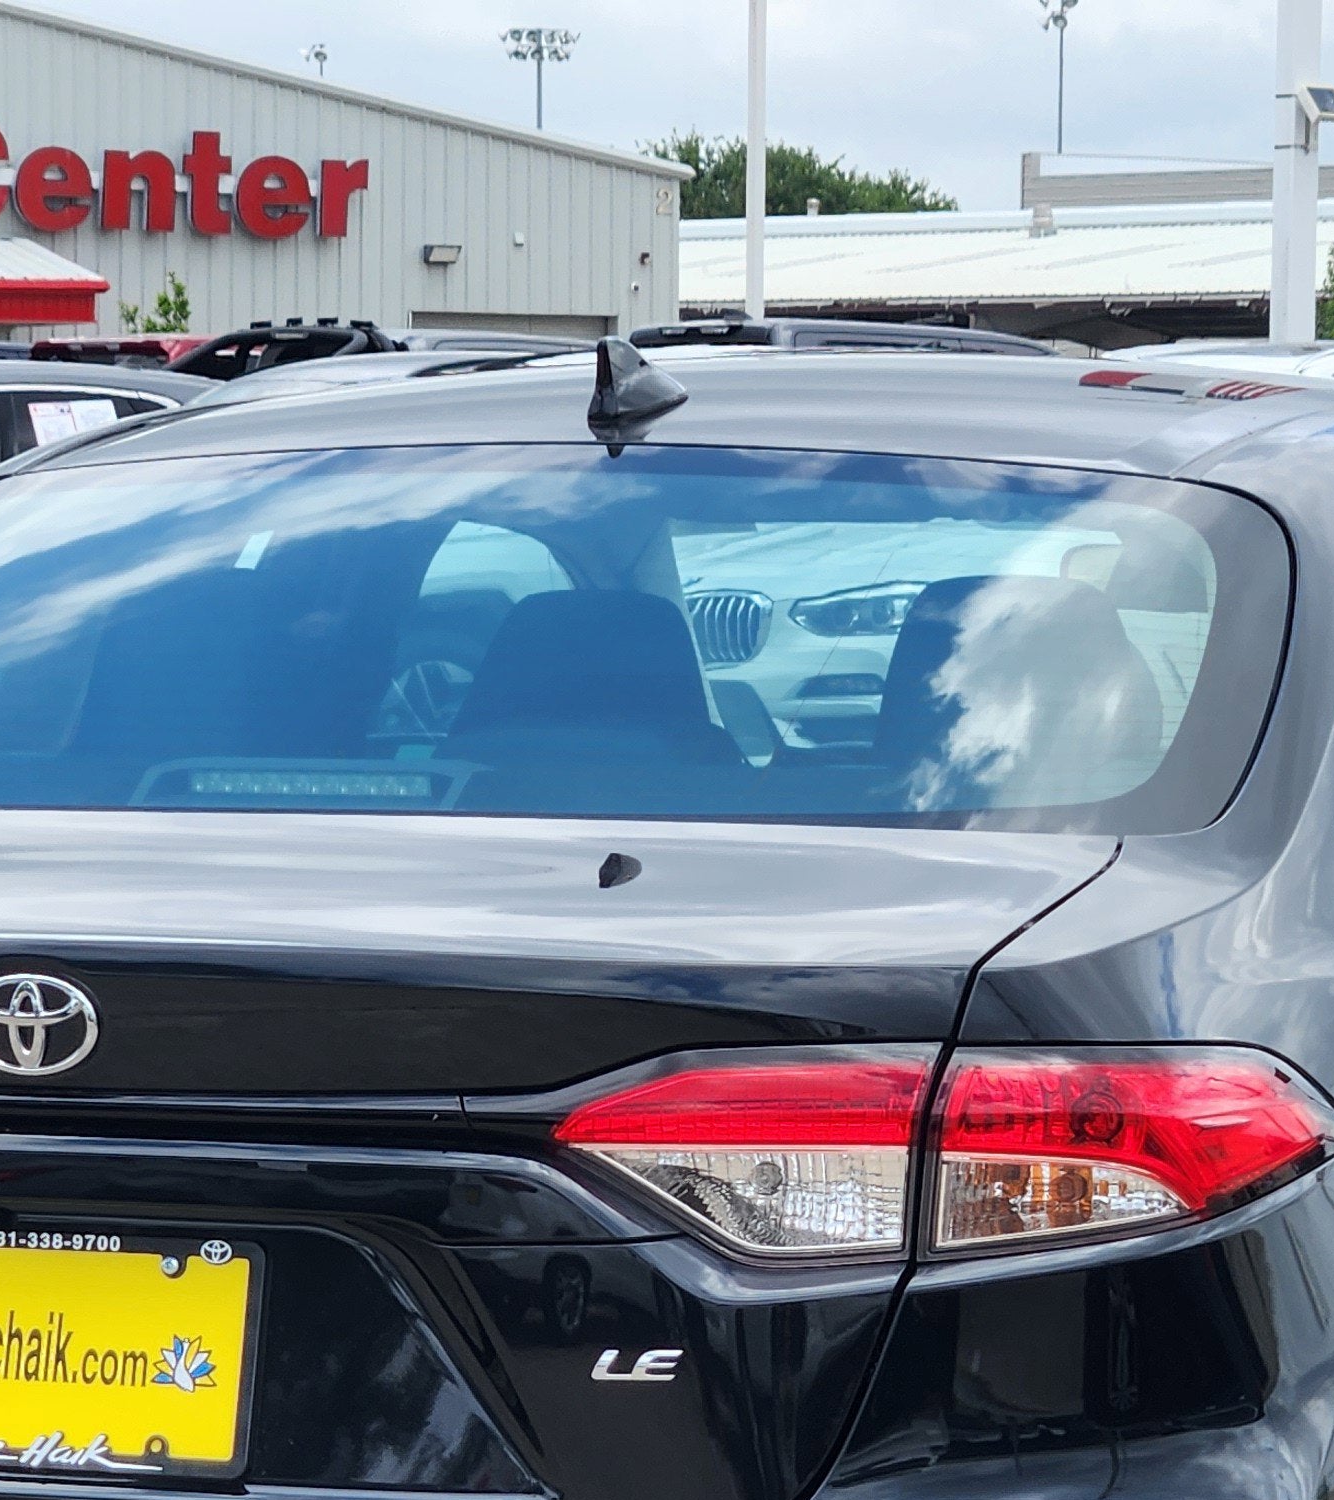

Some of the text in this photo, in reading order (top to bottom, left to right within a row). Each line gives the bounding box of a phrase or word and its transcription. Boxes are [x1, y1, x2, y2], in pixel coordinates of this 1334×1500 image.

[655, 188, 673, 215] 2
[590, 1348, 685, 1381] LE
[18, 1430, 119, 1469] Haik
